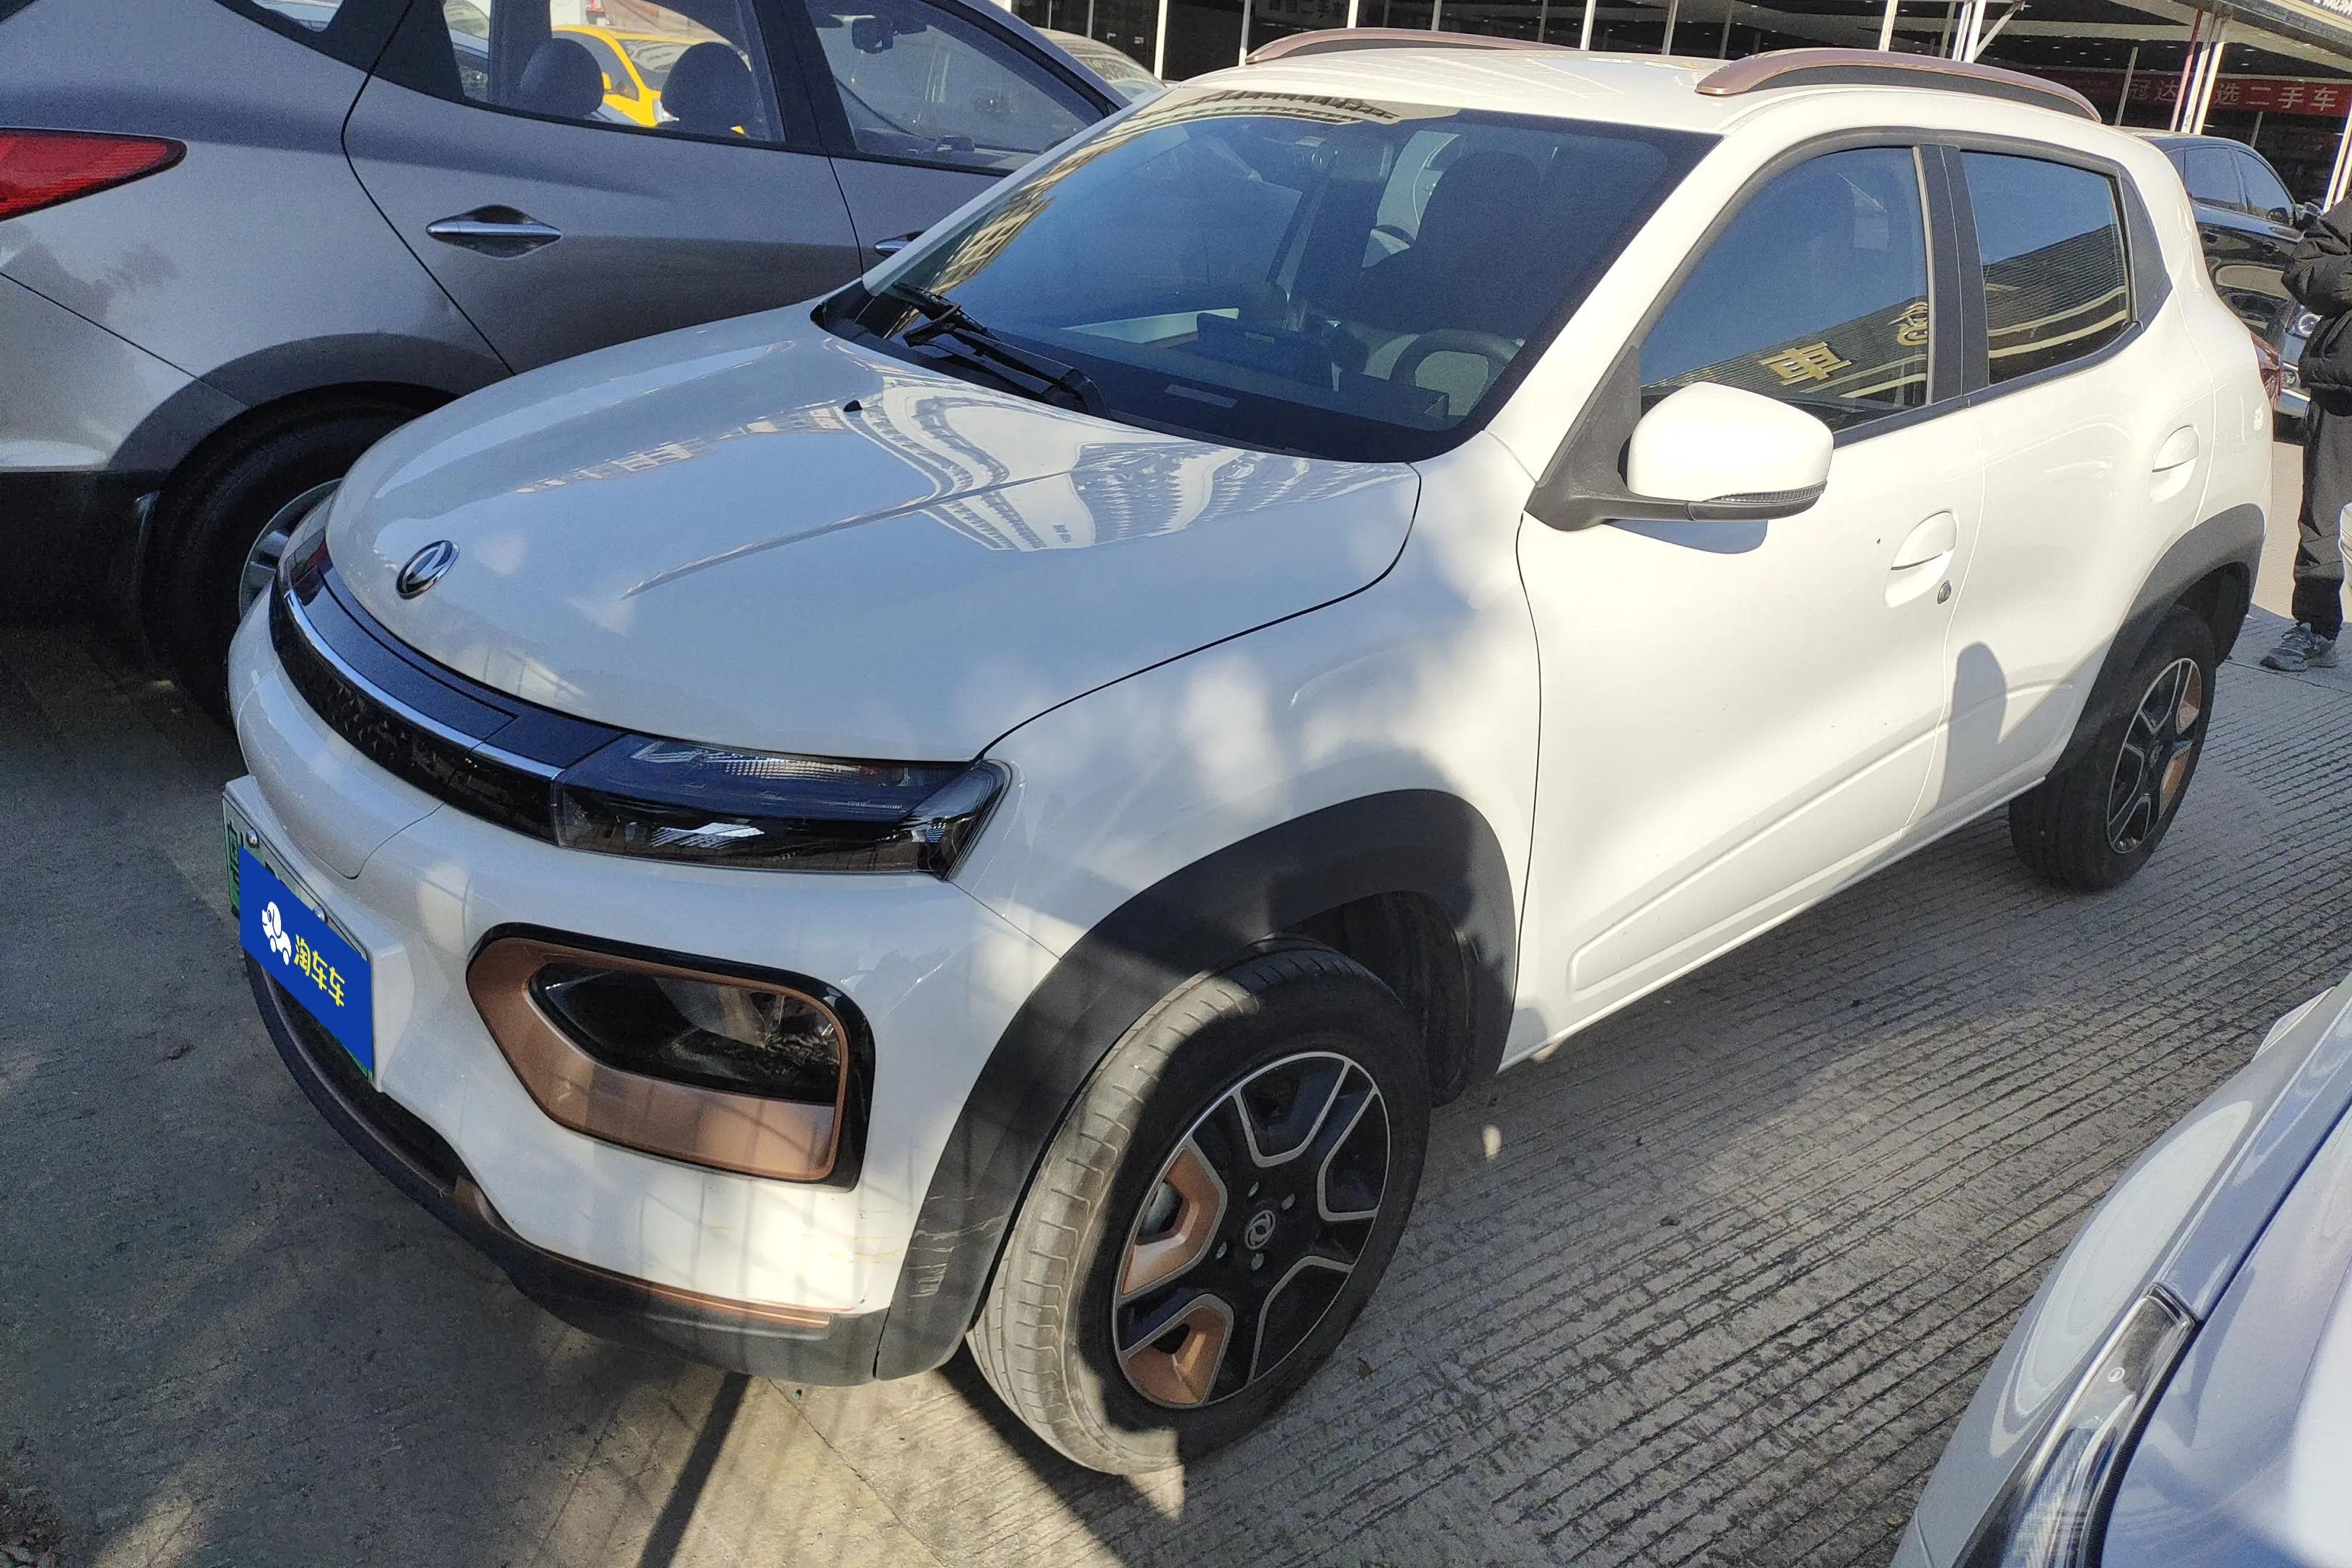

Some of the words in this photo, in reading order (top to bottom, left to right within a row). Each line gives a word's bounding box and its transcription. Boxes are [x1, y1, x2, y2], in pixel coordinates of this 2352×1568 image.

[2128, 79, 2339, 112] 冠达选二手车
